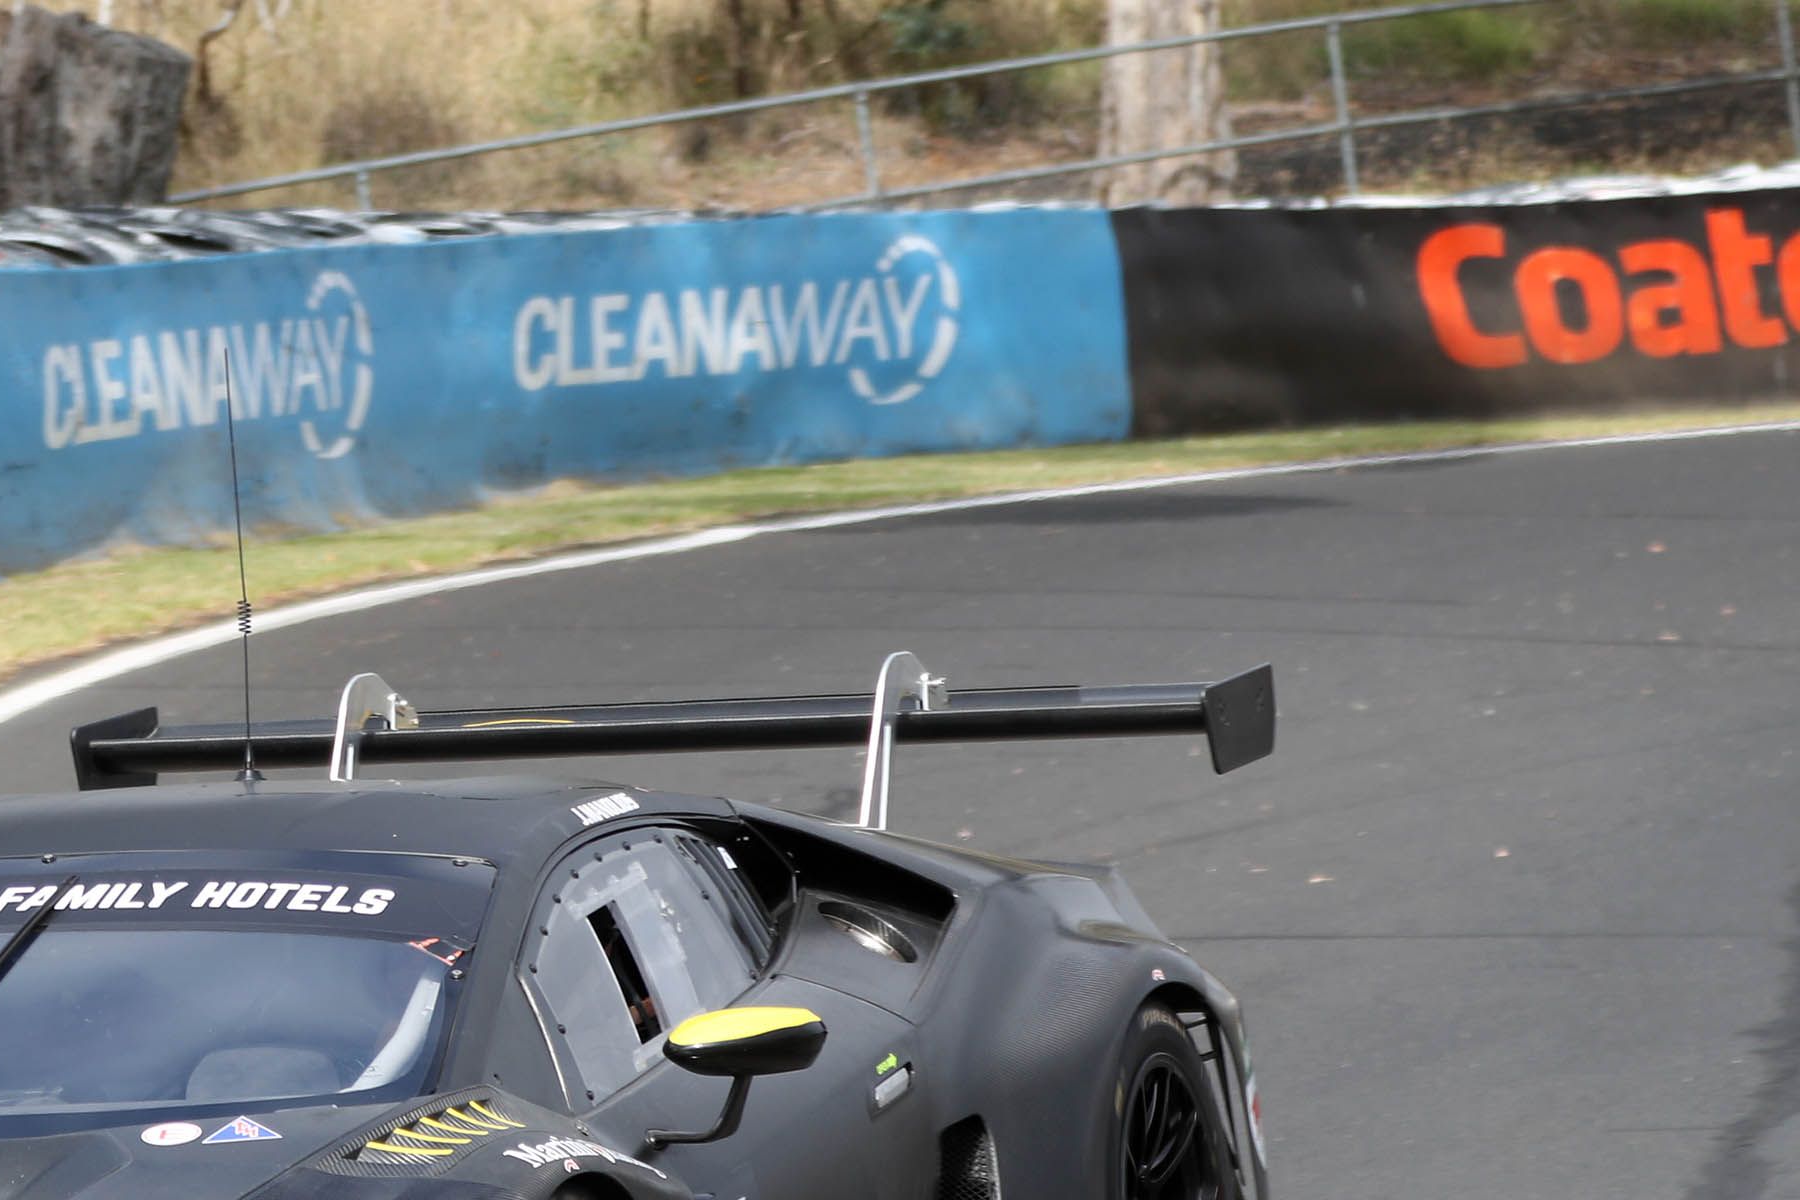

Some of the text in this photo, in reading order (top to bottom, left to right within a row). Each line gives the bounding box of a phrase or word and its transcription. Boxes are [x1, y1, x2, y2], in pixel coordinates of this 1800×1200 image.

[513, 274, 933, 391] CLEANAWAY
[1416, 206, 1800, 369] Coat
[42, 315, 349, 449] CLEANAWAY
[191, 882, 396, 916] HOTELS
